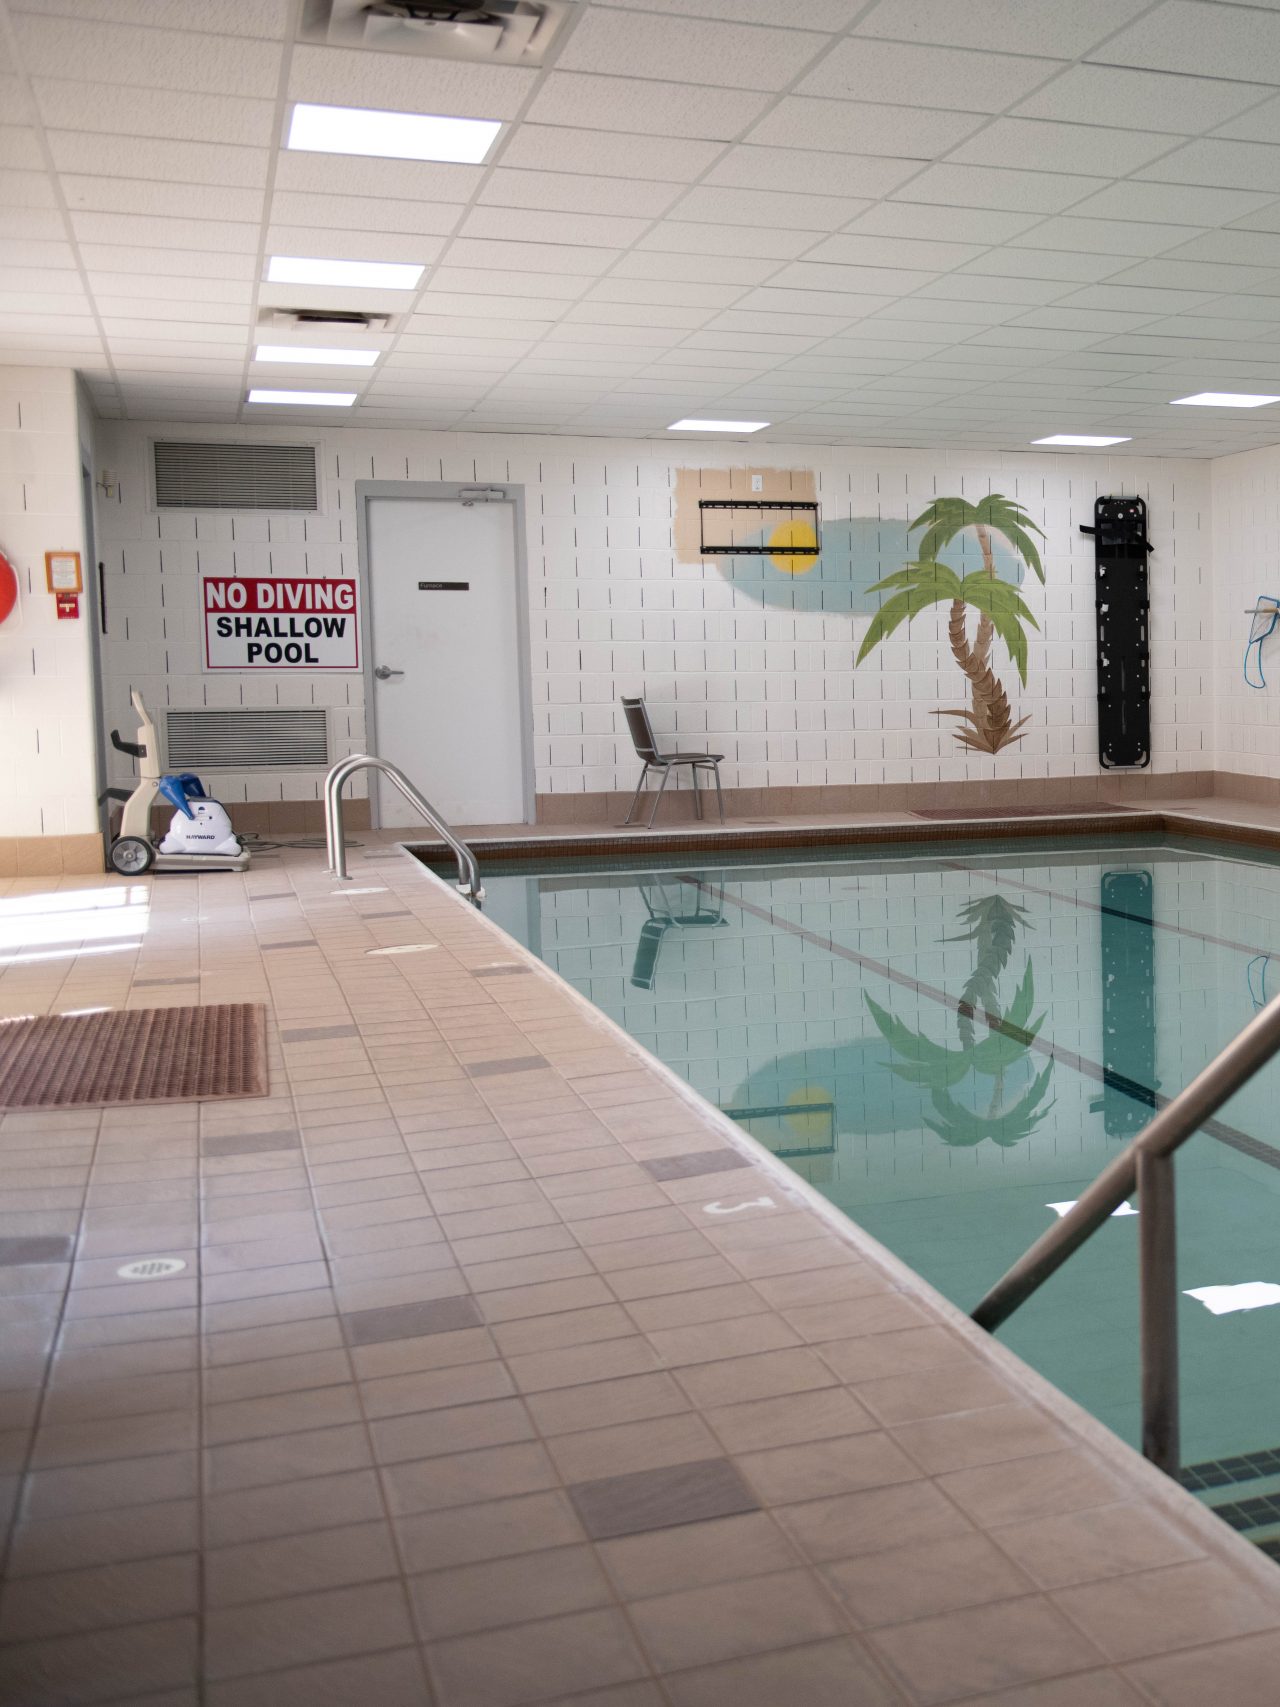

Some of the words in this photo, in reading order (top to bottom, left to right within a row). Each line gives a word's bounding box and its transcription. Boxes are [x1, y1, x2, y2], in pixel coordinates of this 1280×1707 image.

[206, 582, 247, 609] NO
[256, 583, 354, 610] DIVING
[216, 616, 346, 638] SHALLOW
[247, 642, 319, 664] POOL
